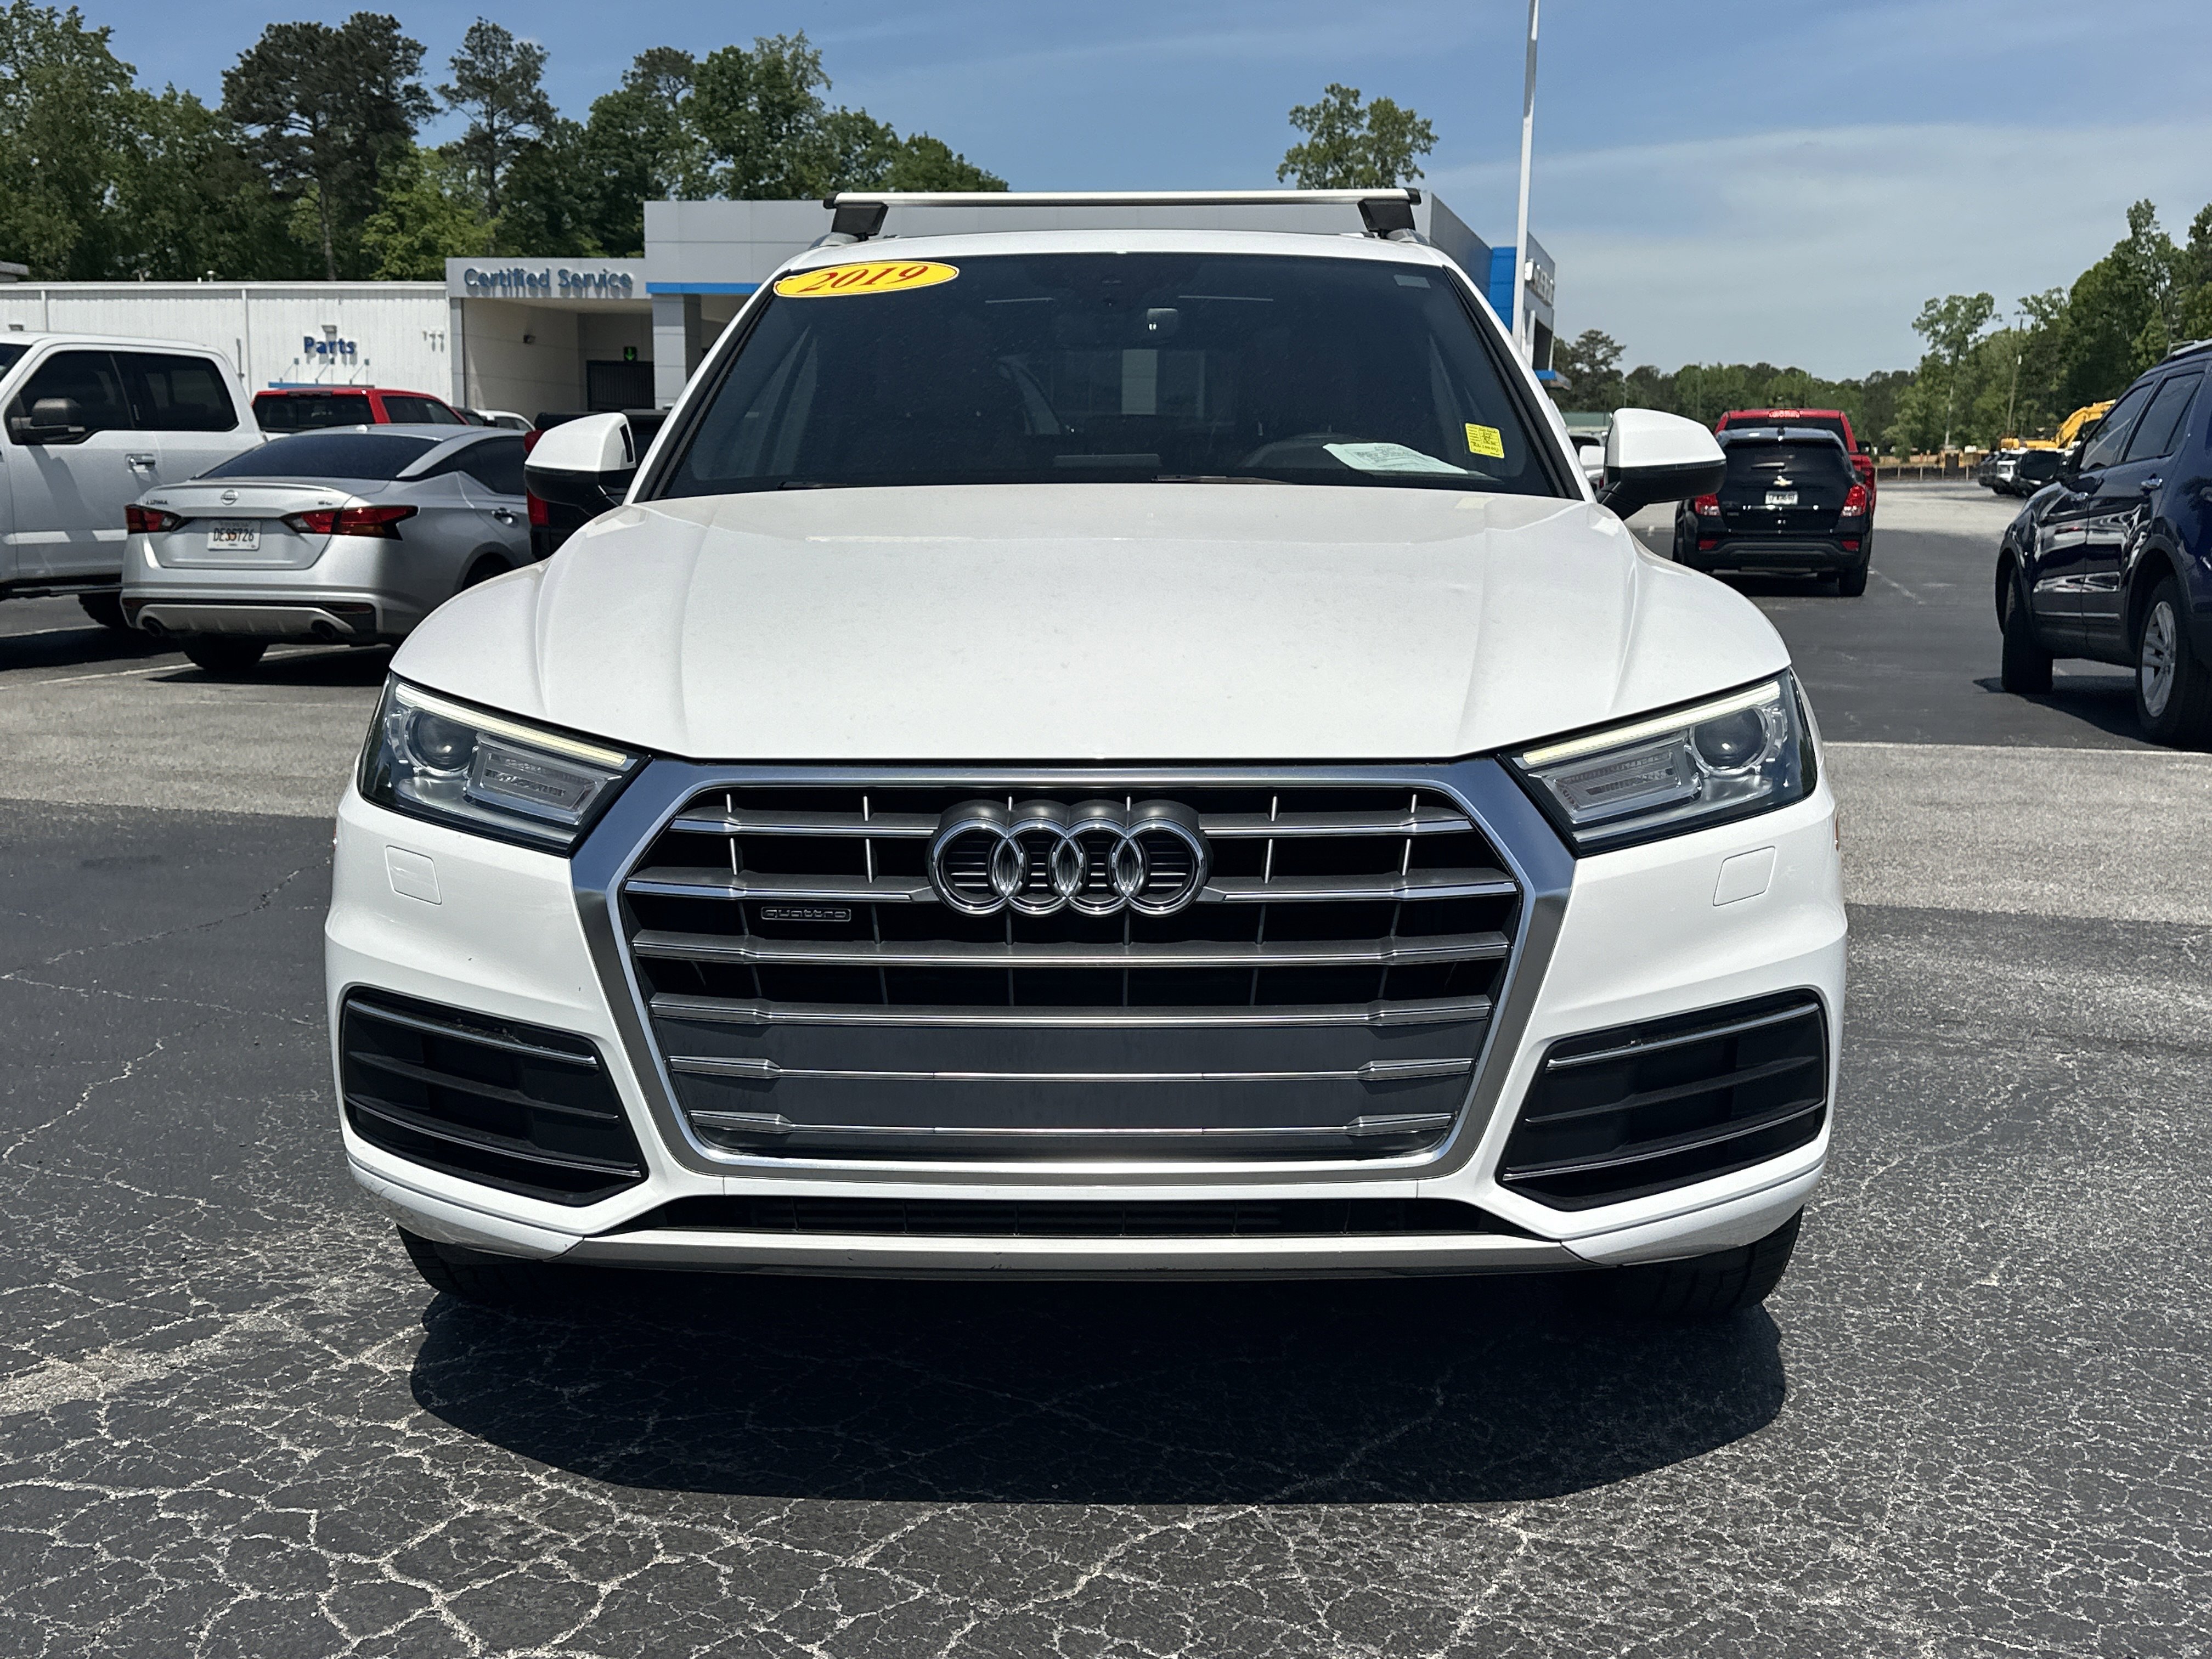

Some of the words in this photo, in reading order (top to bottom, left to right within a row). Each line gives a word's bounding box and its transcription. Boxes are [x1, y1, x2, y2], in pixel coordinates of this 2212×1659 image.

[464, 268, 550, 287] Certified
[557, 268, 633, 287] Service
[795, 265, 929, 293] 2019
[303, 336, 356, 354] Parts
[765, 909, 847, 919] quattro
